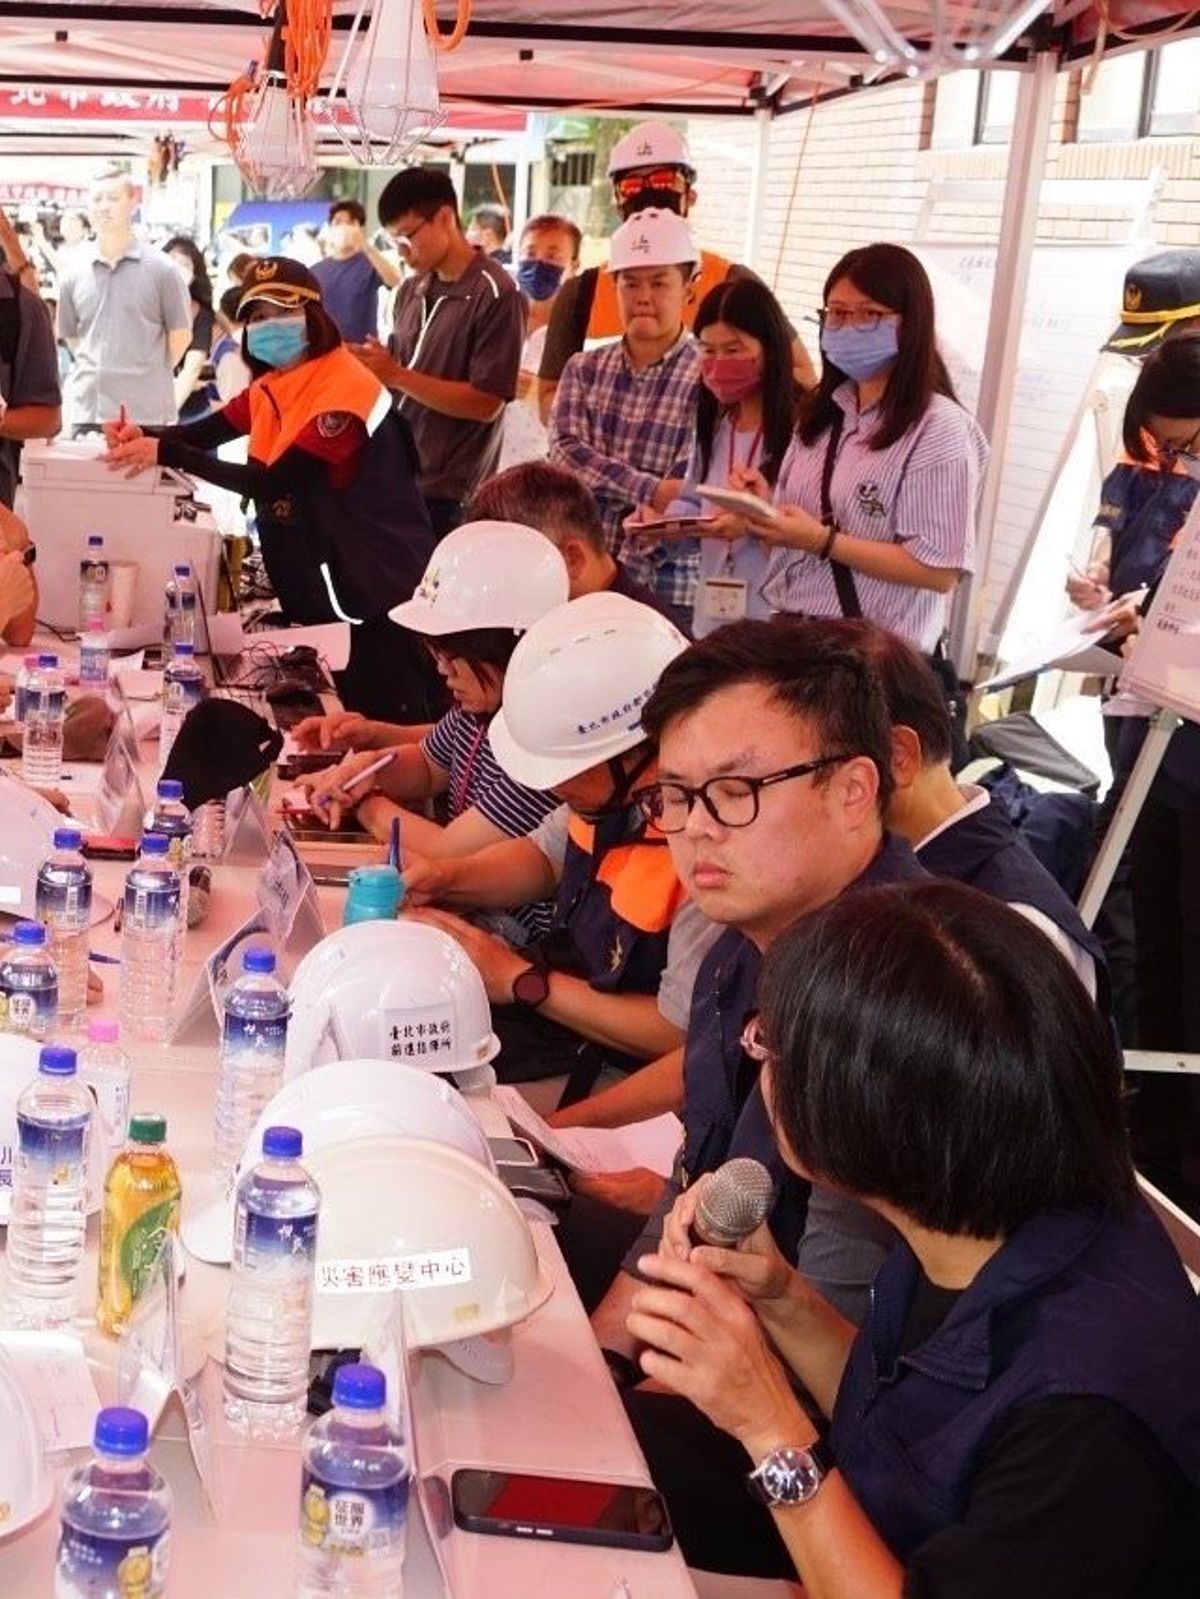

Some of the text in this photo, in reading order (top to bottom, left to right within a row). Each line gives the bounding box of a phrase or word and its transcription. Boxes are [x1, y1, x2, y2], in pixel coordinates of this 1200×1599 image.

[321, 1256, 466, 1288] 災害應變中心
